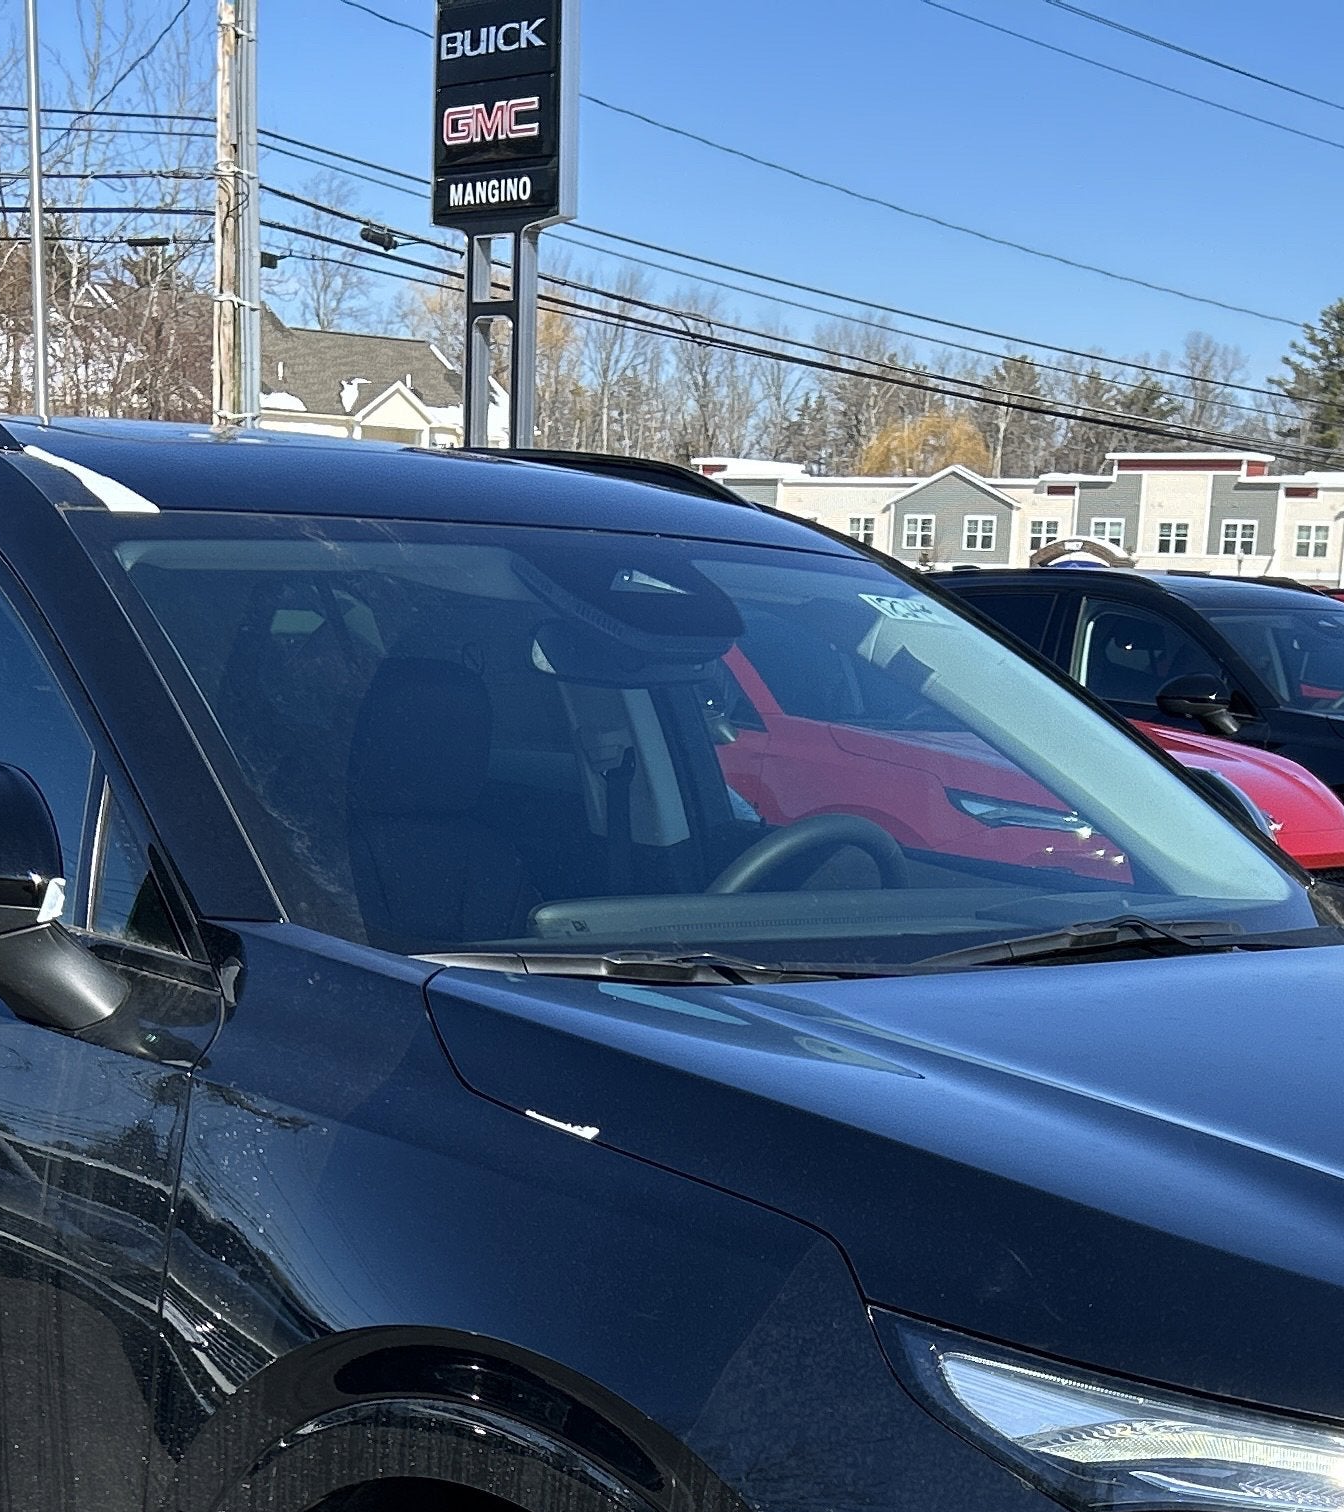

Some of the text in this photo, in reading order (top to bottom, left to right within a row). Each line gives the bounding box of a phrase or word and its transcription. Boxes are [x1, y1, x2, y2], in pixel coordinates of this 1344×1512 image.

[440, 17, 547, 61] BUICK
[442, 96, 540, 146] GMC
[449, 176, 532, 207] MANGINO
